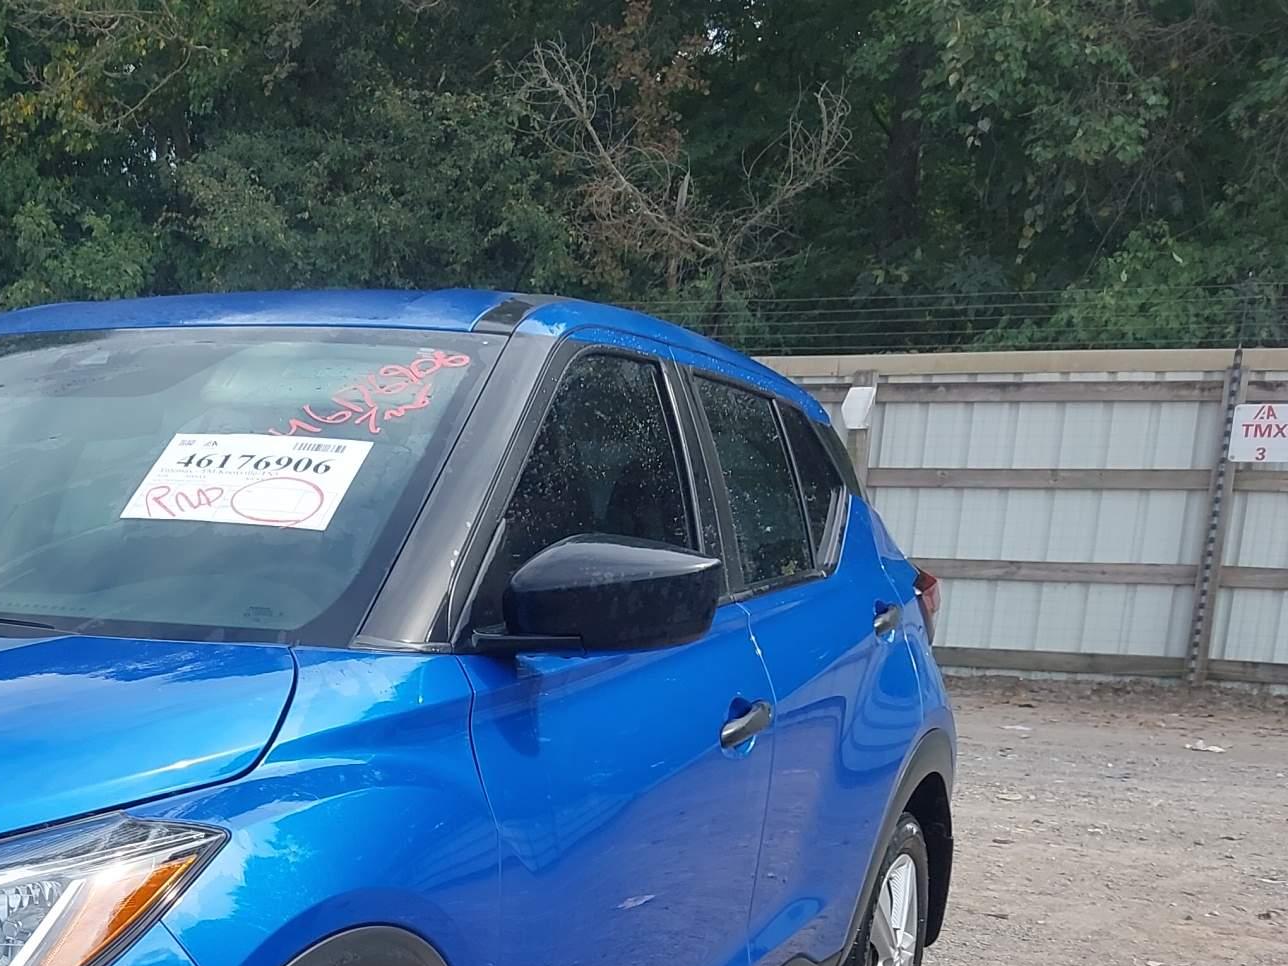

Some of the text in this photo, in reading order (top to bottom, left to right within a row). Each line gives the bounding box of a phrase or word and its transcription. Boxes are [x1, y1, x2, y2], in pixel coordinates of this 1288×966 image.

[1242, 423, 1288, 439] TMX
[1255, 447, 1266, 461] 3
[176, 452, 337, 475] 46176906
